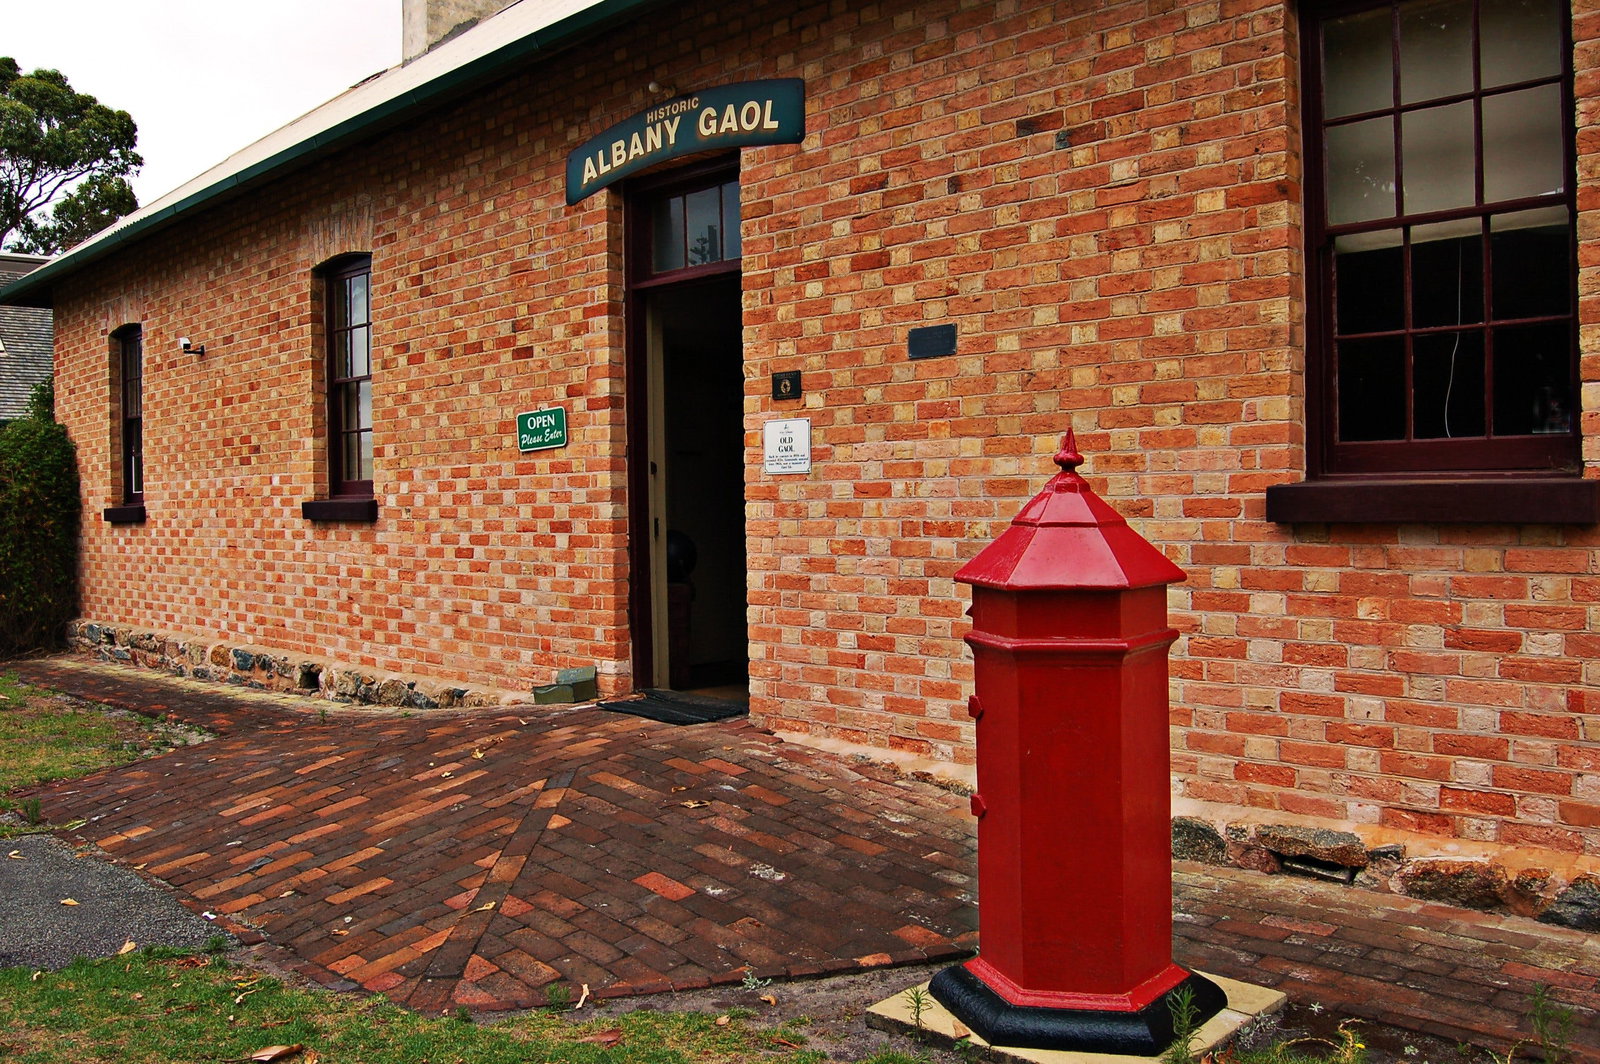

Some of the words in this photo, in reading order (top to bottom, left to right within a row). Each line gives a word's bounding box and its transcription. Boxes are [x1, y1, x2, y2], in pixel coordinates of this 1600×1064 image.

[647, 97, 699, 123] HISTORIC
[583, 116, 681, 185] ALBANY
[698, 100, 779, 136] GAOL
[527, 414, 555, 430] OPEN
[521, 434, 543, 447] Please
[544, 428, 562, 442] Enter
[778, 445, 795, 453] GAOL
